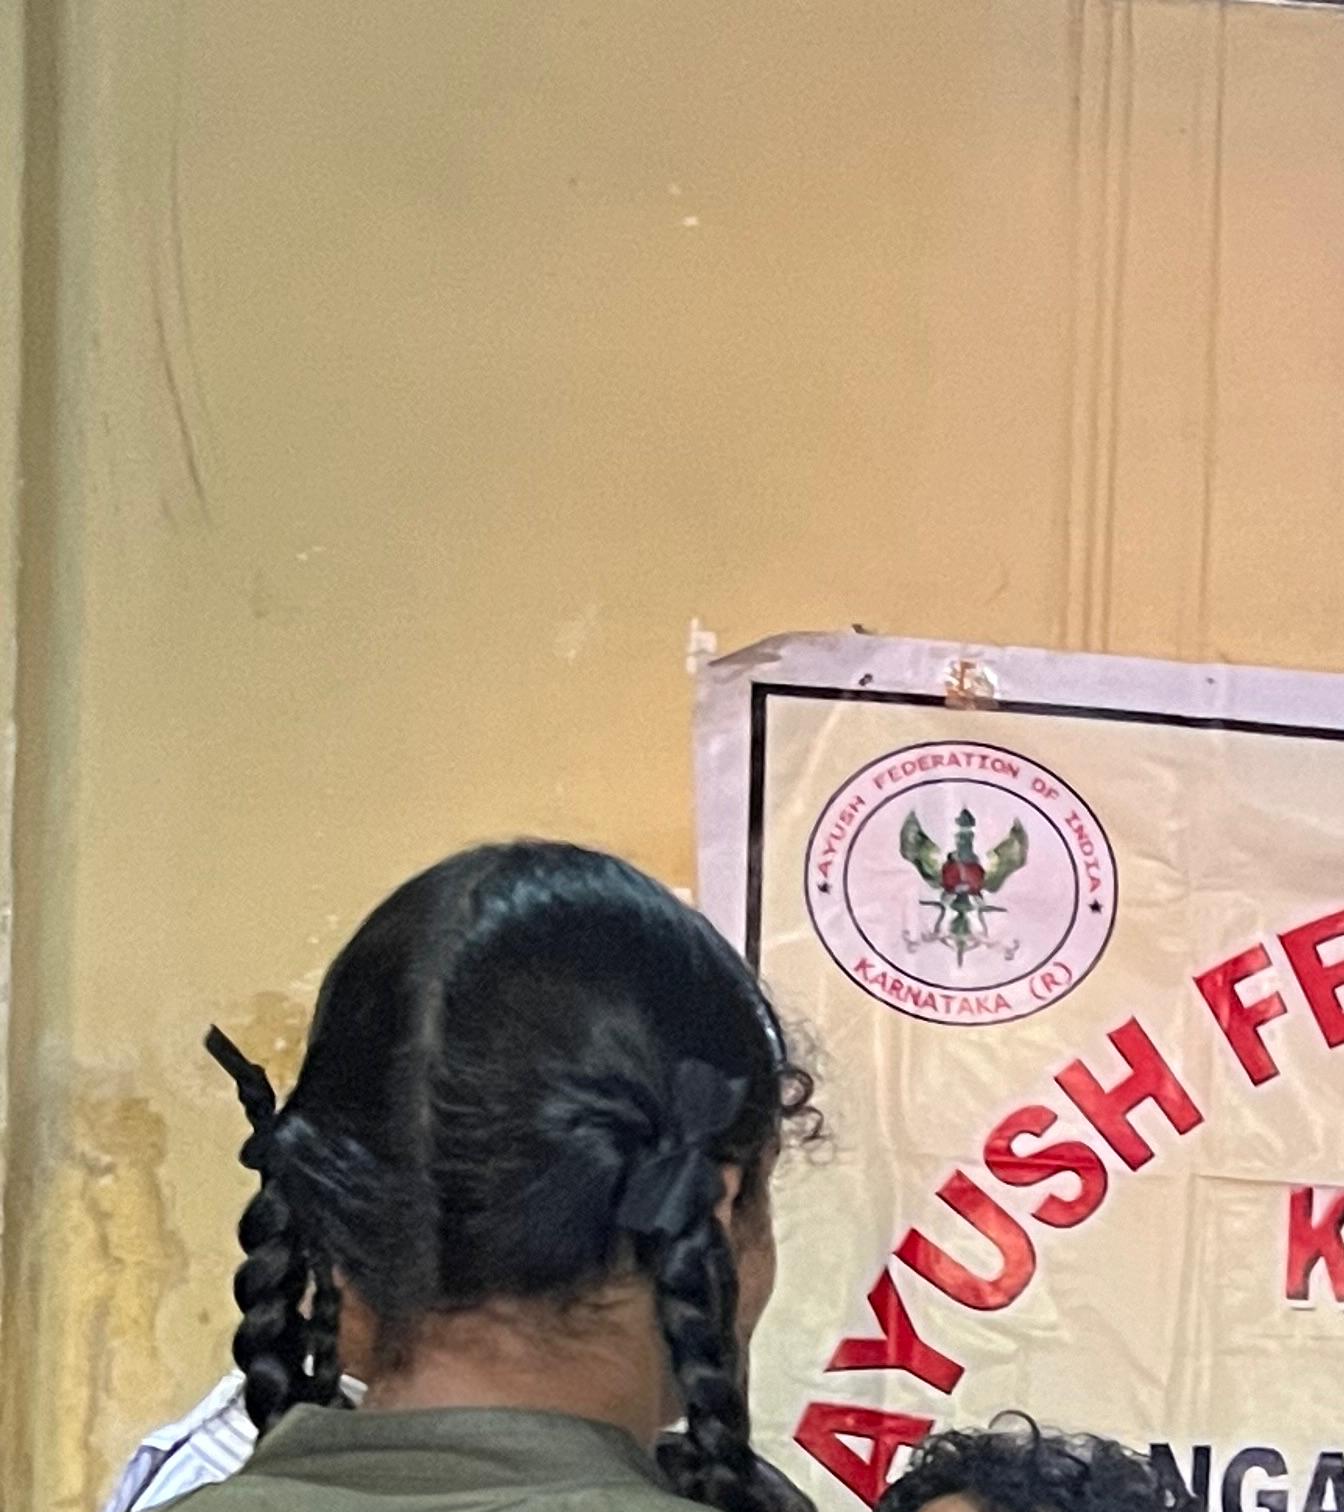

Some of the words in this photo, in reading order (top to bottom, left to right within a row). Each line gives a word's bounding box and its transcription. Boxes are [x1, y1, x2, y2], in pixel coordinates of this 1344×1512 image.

[817, 795, 866, 878] AYUSH
[872, 752, 1020, 790] FEDERATION
[1030, 777, 1060, 801] OF
[1065, 810, 1102, 893] INDIA
[854, 957, 1012, 1016] KARNATAKA
[1029, 961, 1074, 1002] (R)
[794, 1017, 1204, 1510] AYUSH
